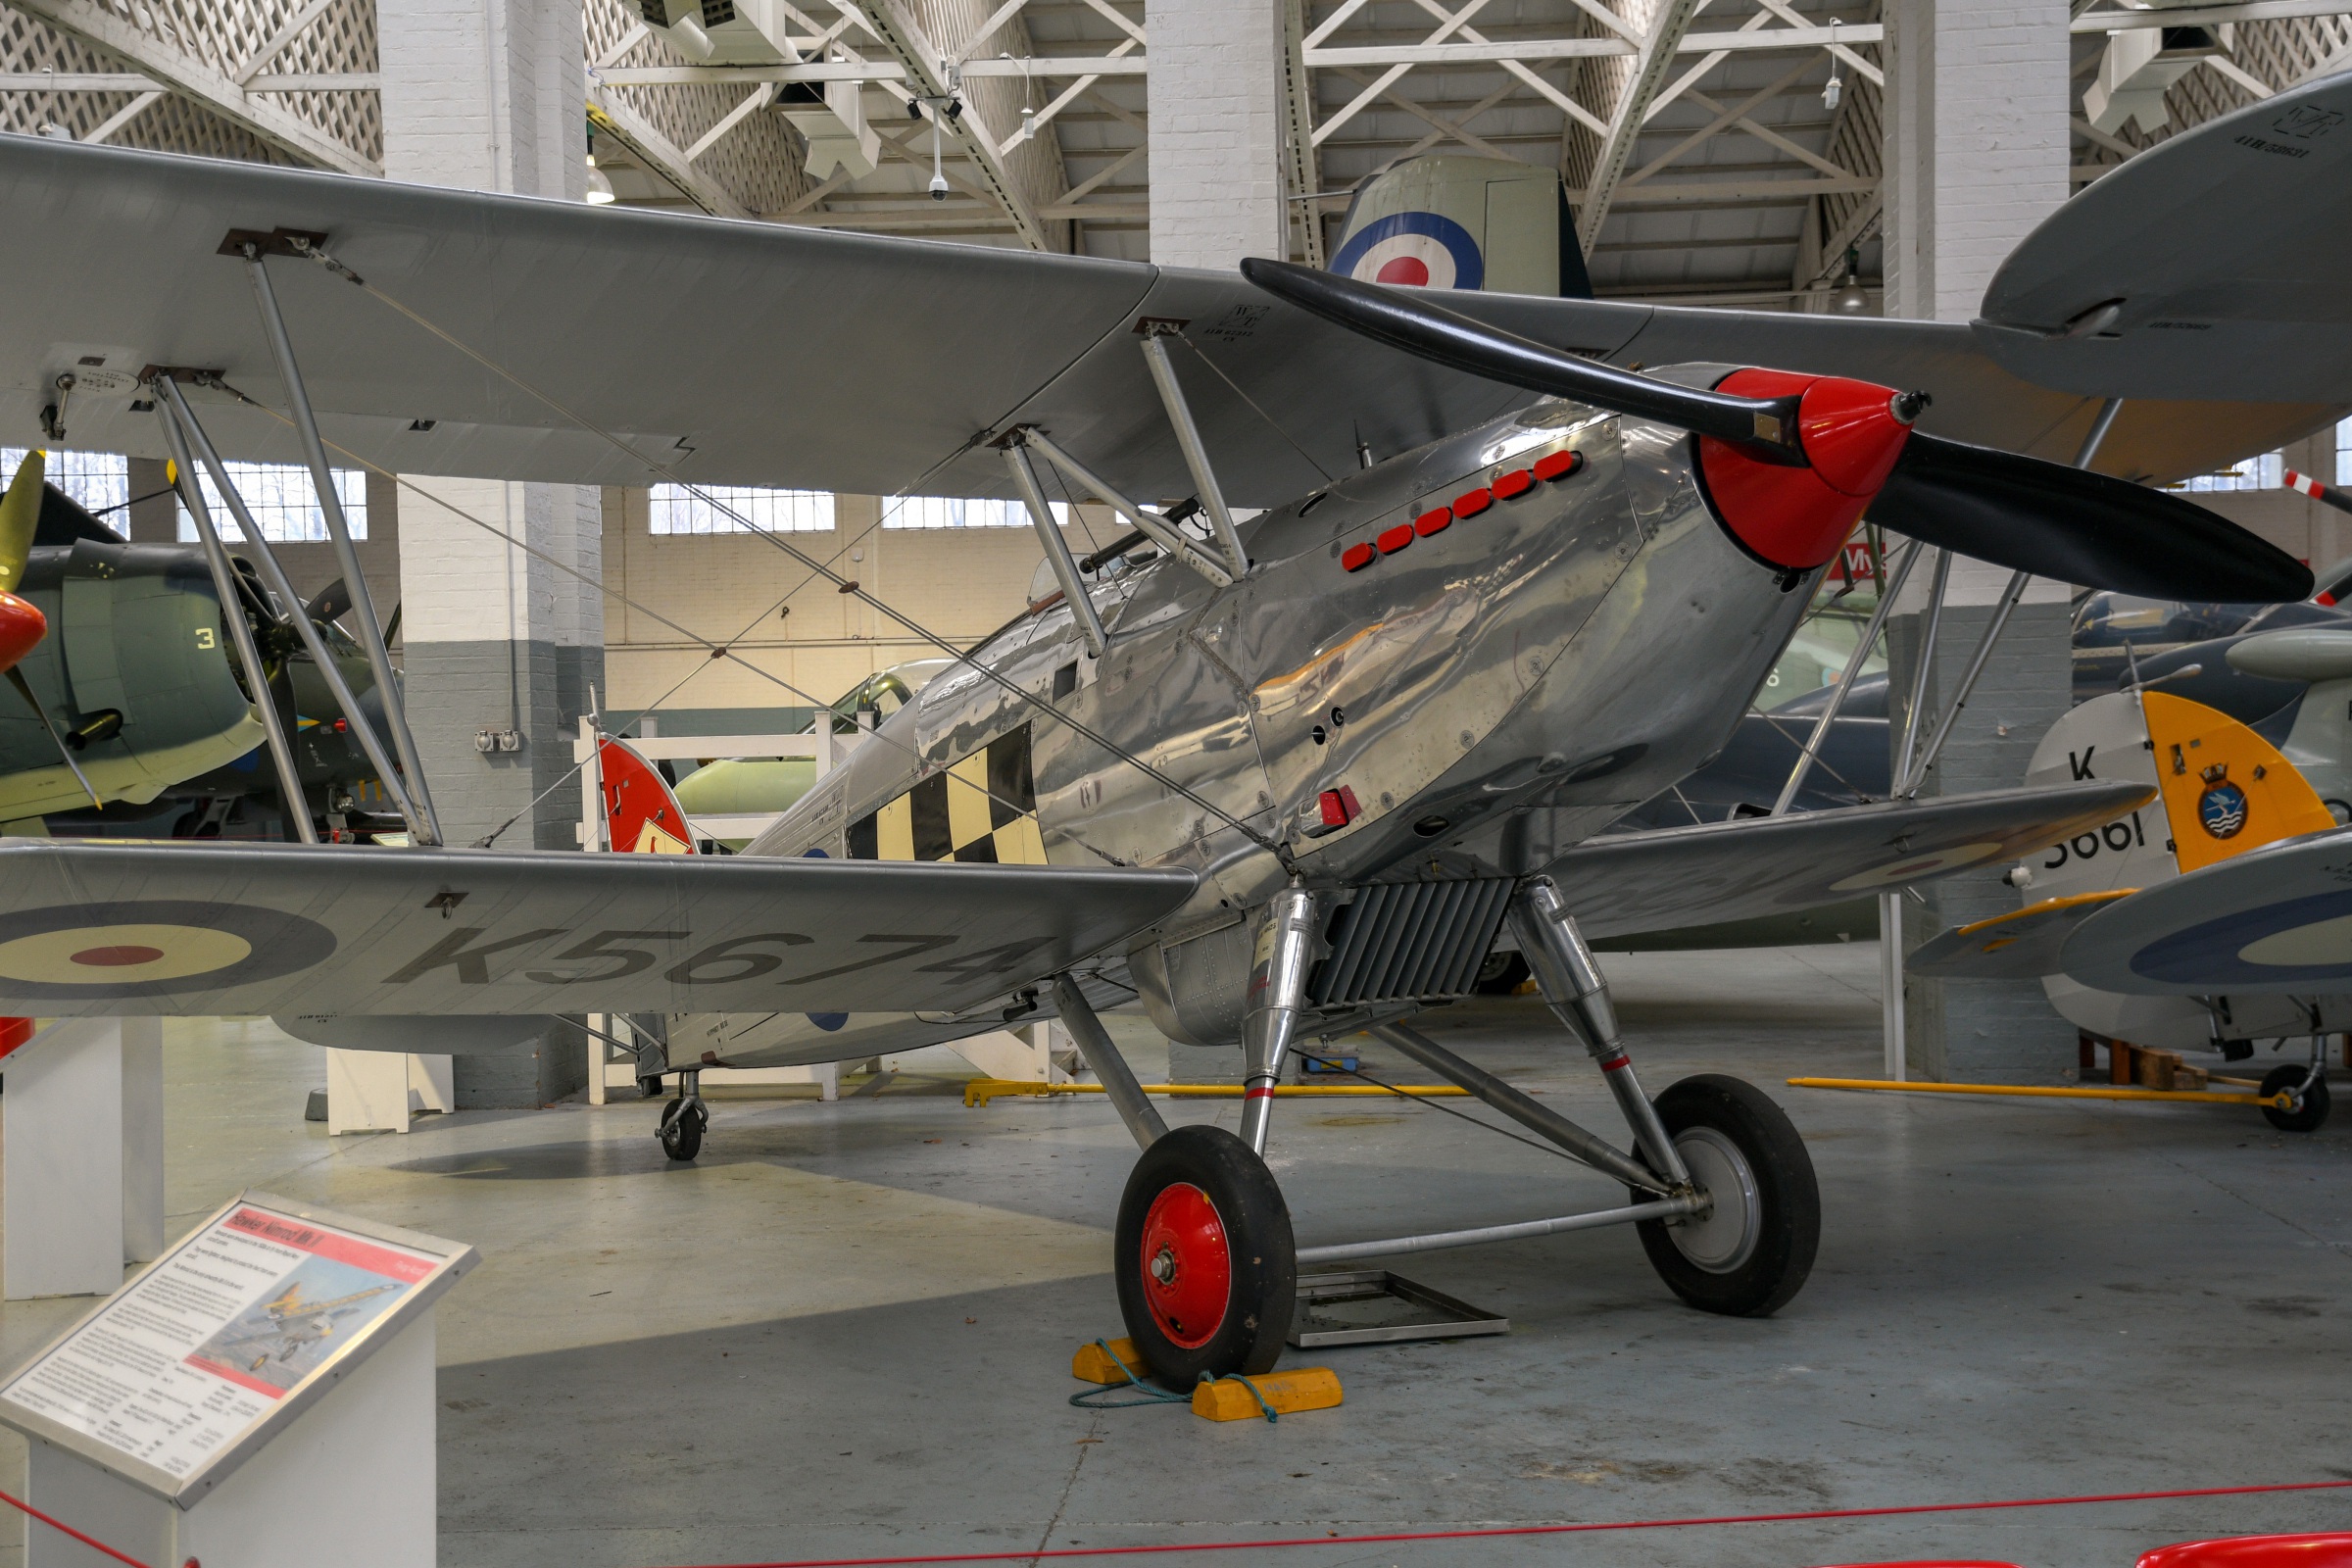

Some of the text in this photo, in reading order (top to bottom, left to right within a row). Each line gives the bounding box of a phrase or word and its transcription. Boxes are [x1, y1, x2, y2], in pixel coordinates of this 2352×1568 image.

[195, 627, 216, 650] 3
[2068, 745, 2095, 781] K
[381, 927, 1059, 985] K5674
